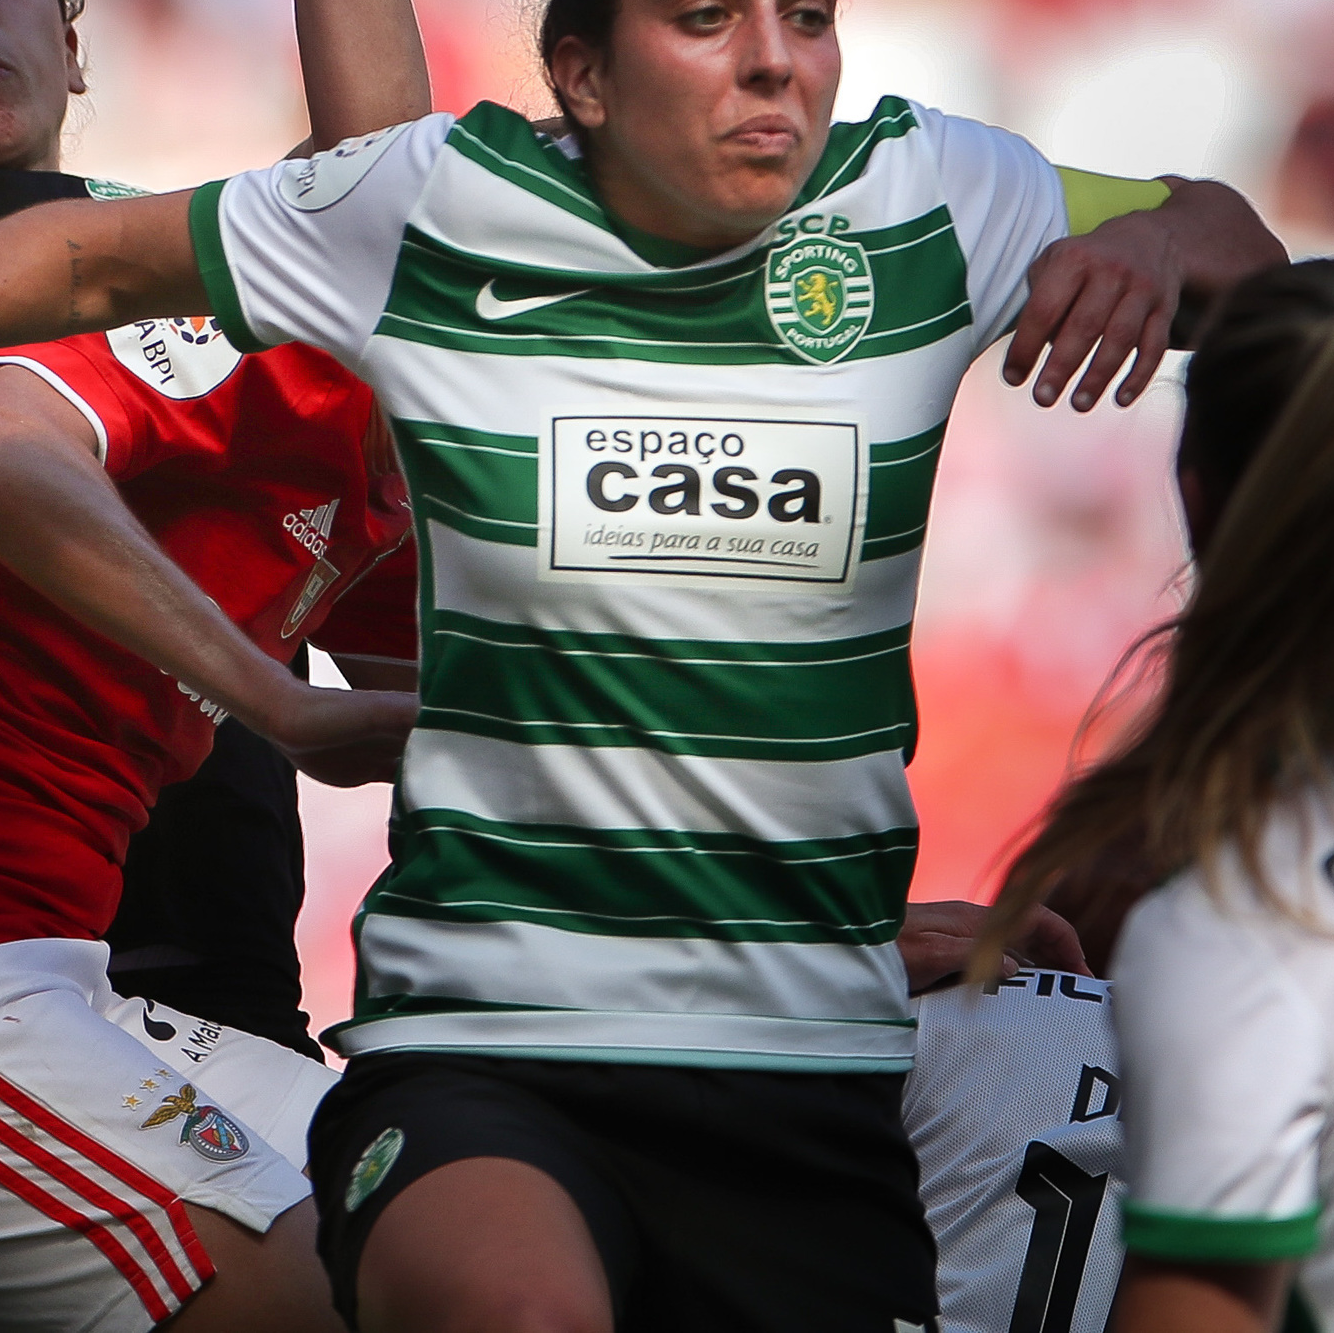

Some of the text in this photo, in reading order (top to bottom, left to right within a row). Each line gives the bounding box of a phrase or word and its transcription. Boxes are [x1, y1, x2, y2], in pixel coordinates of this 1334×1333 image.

[777, 214, 851, 241] SCP
[785, 324, 863, 350] PORTUGAL
[142, 340, 176, 385] BPI
[586, 429, 744, 464] espaço
[586, 460, 822, 523] casa
[282, 513, 328, 560] adidas
[583, 523, 821, 558] ideias para a sua casa
[180, 1046, 208, 1063] A
